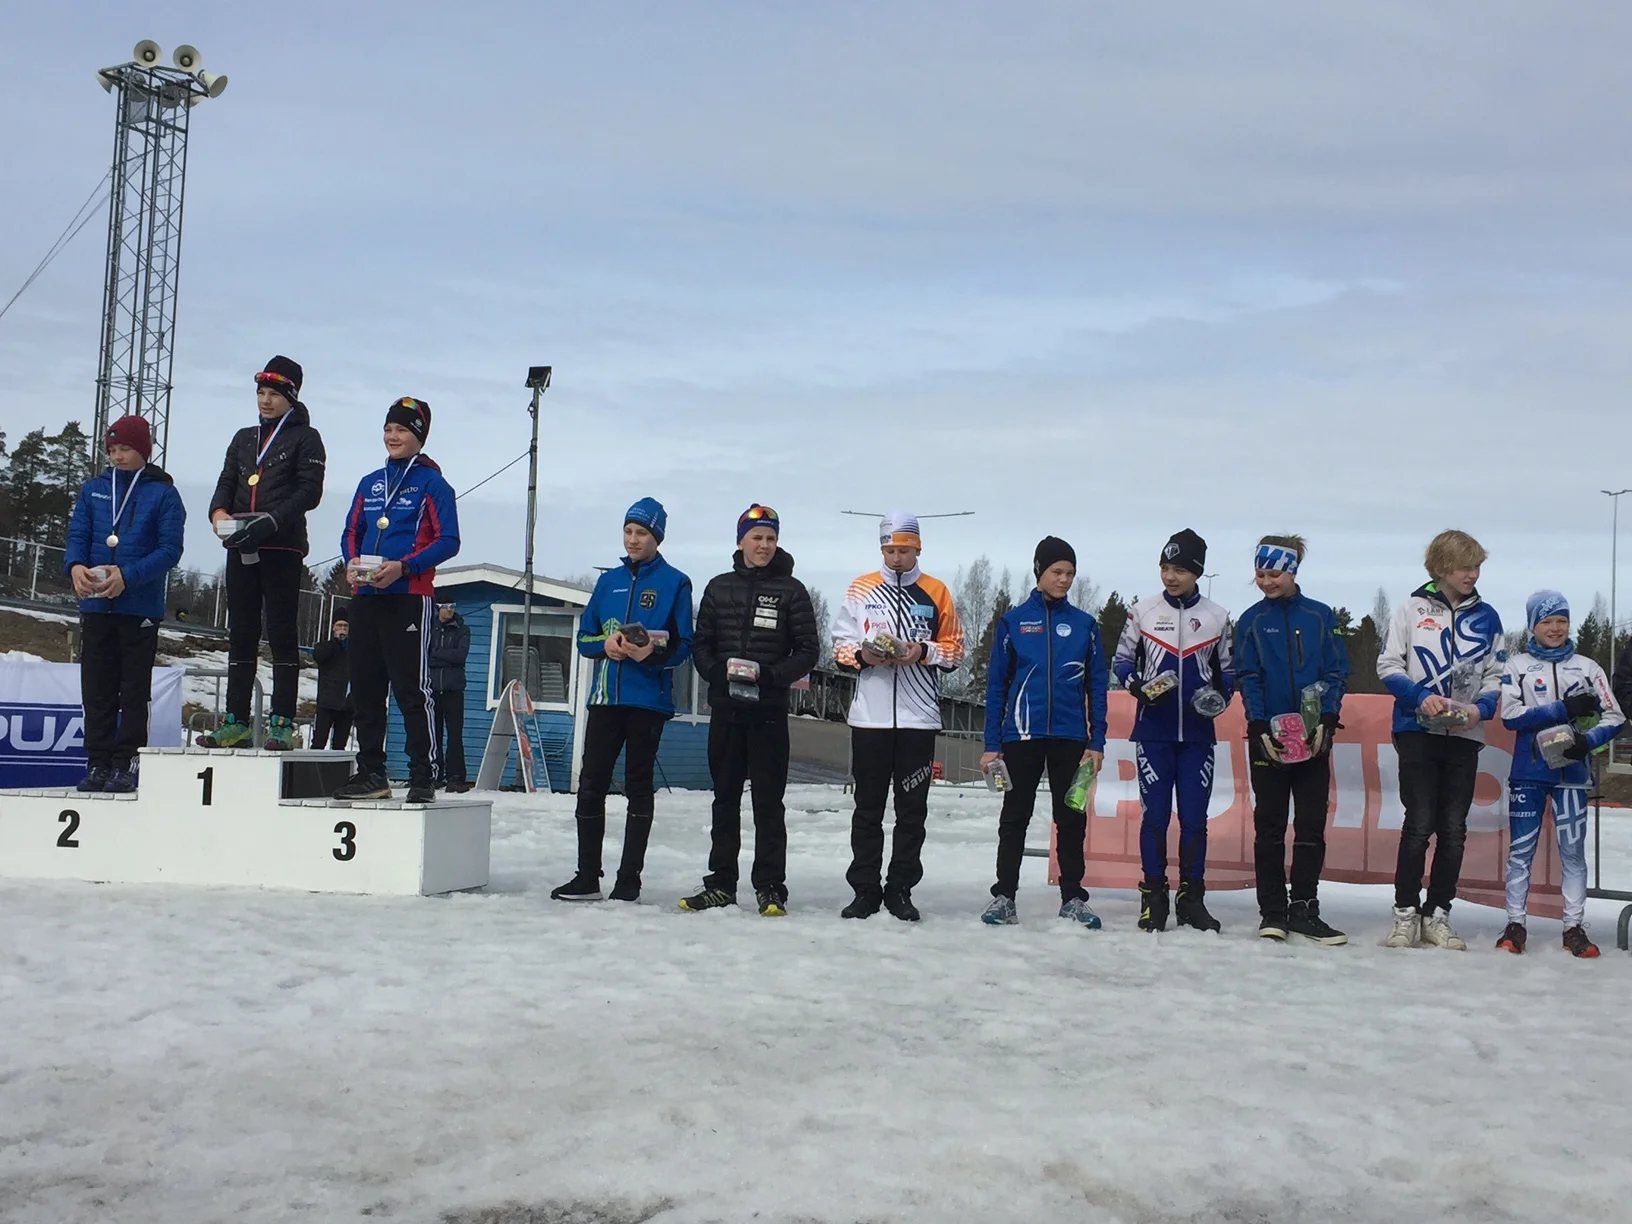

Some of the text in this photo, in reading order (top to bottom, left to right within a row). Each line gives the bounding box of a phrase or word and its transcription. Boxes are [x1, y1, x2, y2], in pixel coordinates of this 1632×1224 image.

[197, 766, 214, 806] 1
[56, 809, 81, 848] 2
[331, 820, 357, 862] 3
